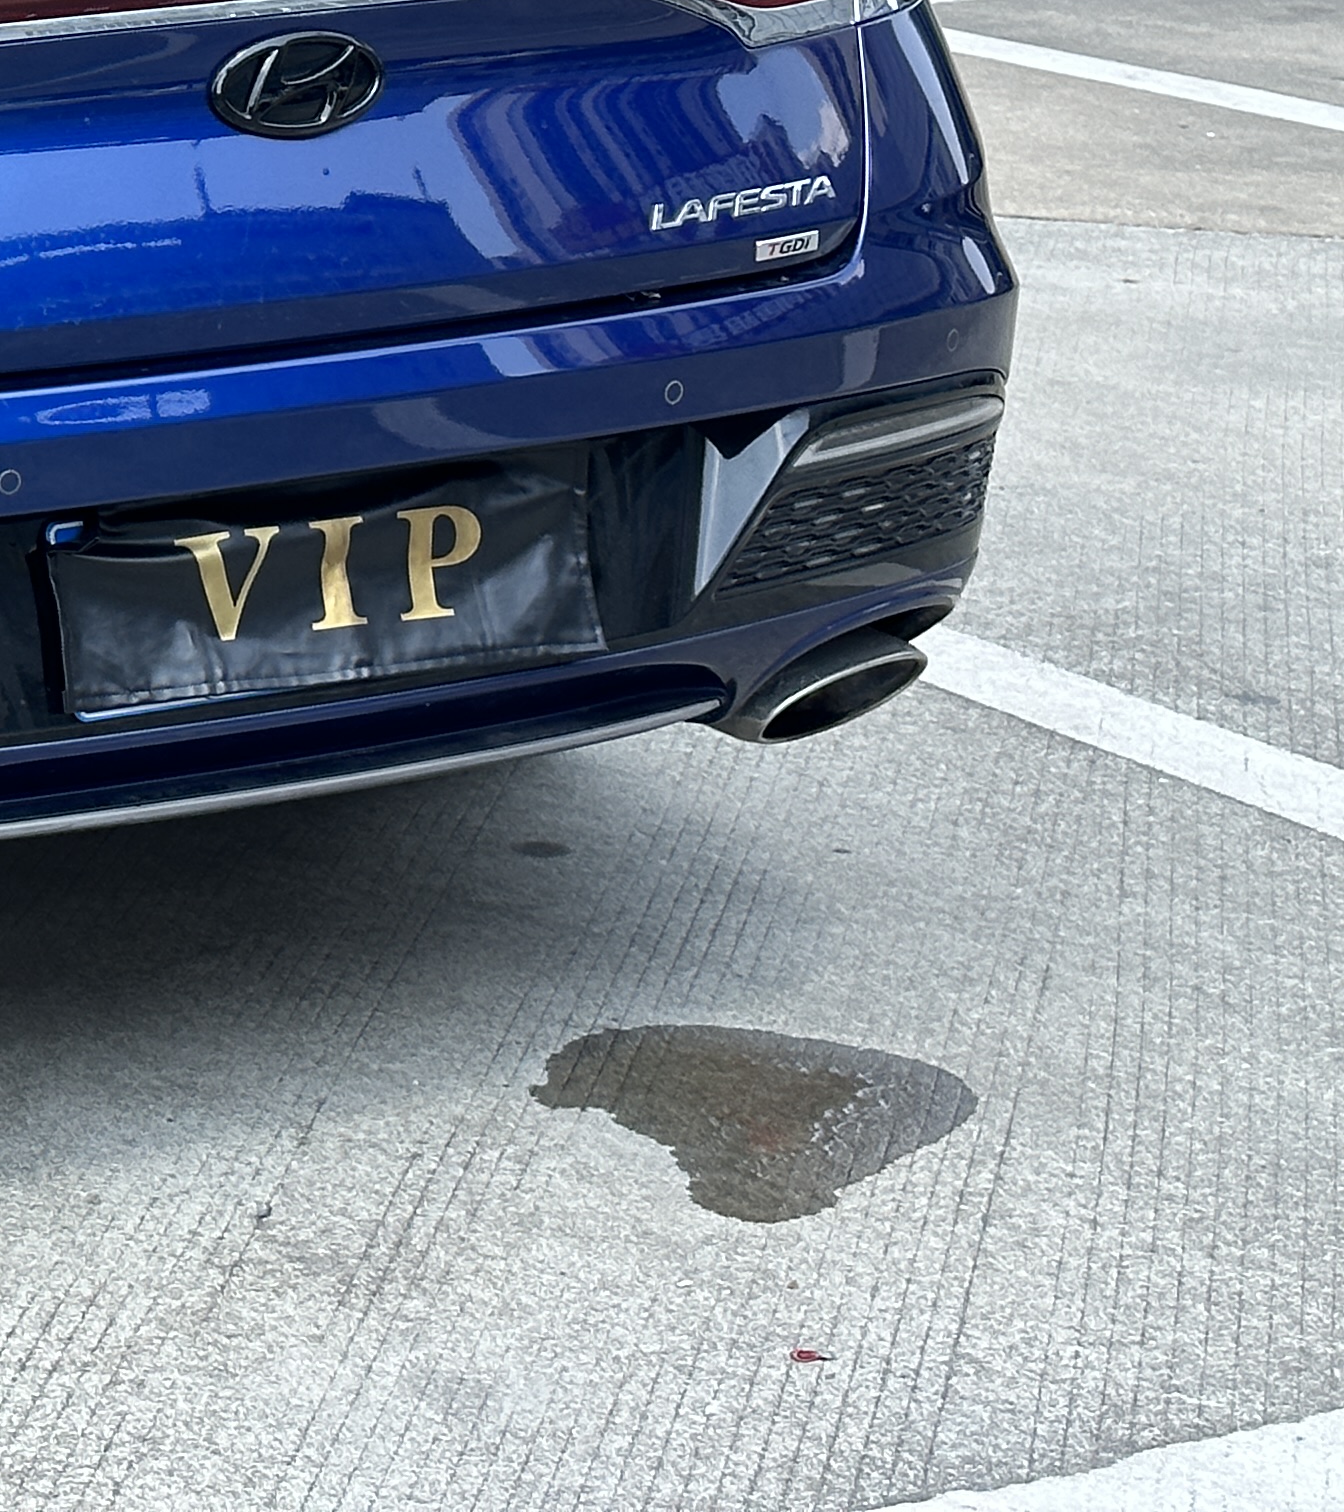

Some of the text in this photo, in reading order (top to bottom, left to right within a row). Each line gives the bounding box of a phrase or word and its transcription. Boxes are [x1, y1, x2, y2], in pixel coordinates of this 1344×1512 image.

[650, 175, 837, 231] LAFESTA
[766, 235, 814, 258] TGDI
[173, 504, 483, 642] VIP
